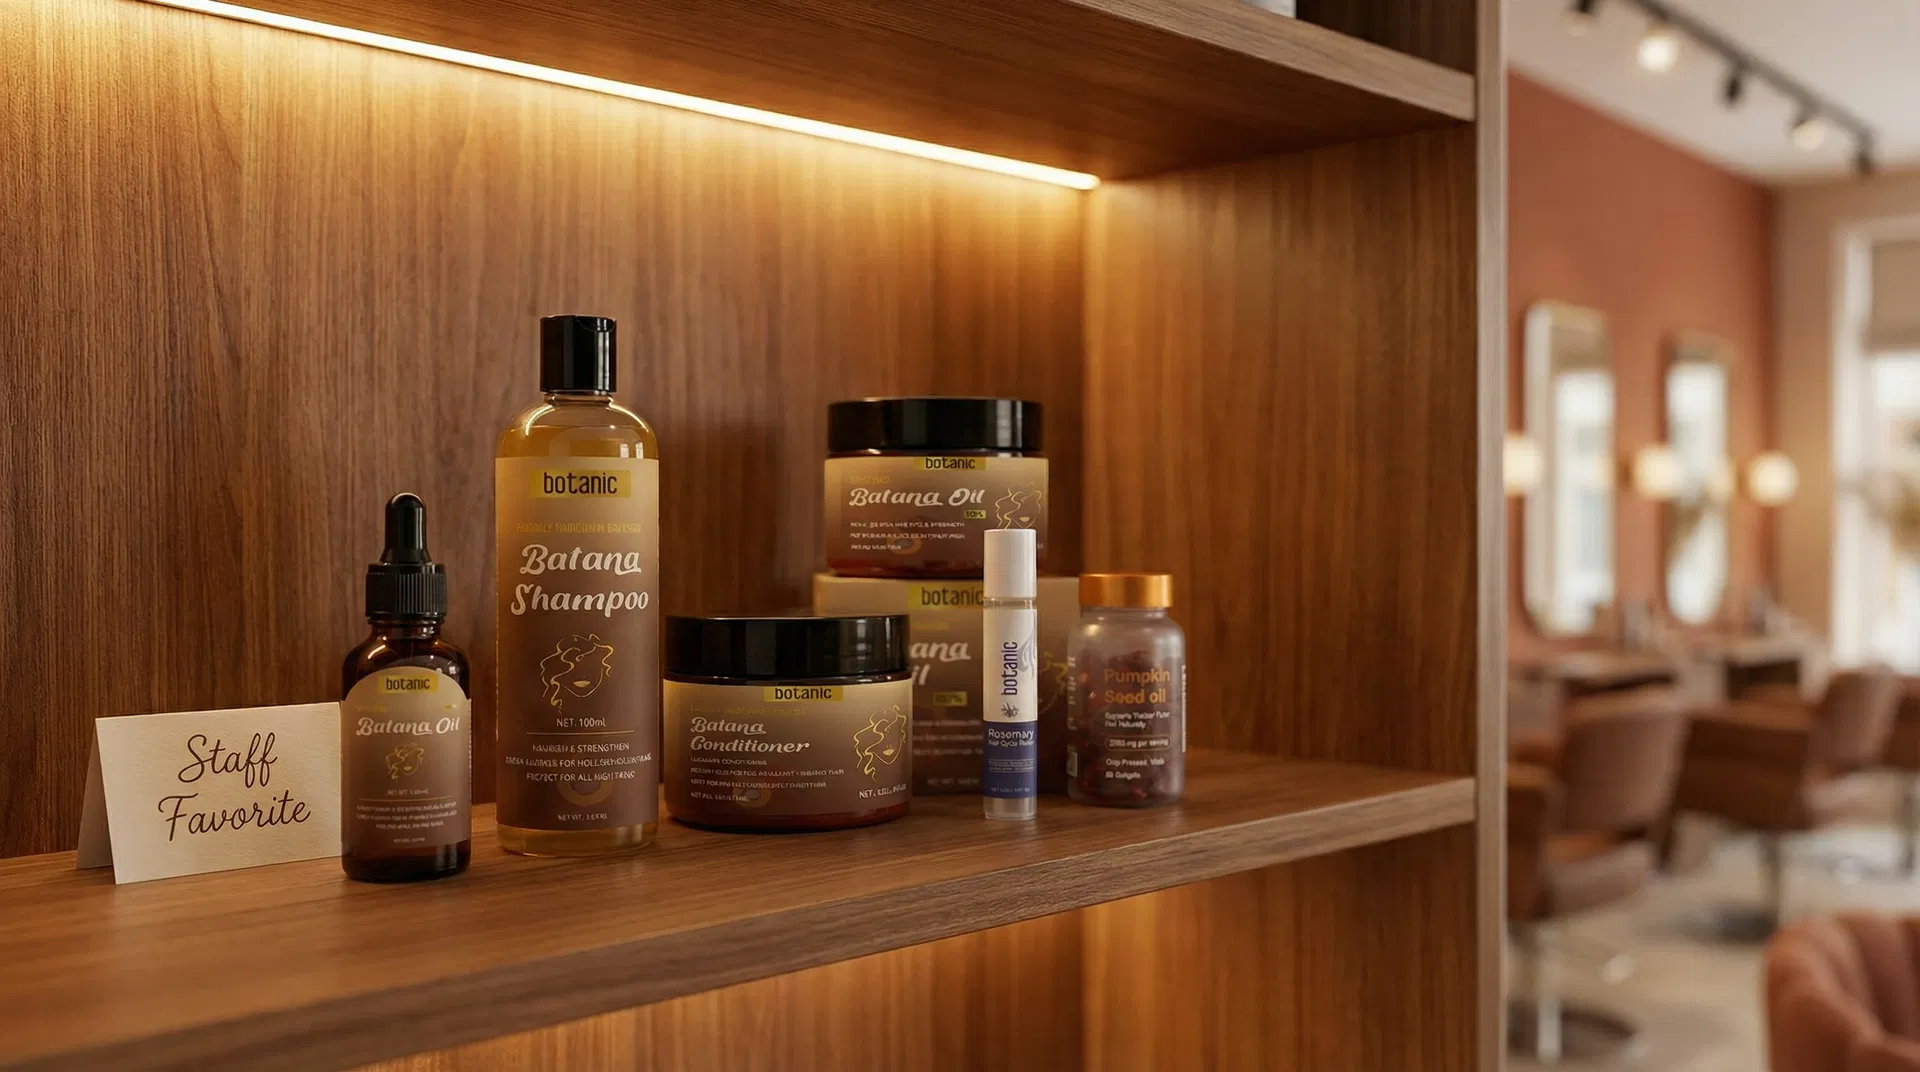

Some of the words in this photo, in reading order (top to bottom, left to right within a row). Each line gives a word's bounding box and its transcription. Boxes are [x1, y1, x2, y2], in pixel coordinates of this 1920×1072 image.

[925, 457, 976, 469] botanic
[543, 472, 618, 494] botanic
[848, 487, 944, 507] Batana
[948, 487, 986, 507] Oil
[519, 544, 642, 576] Batana
[510, 583, 650, 618] Shampoo
[911, 642, 971, 662] ana
[1001, 641, 1018, 696] botanic
[1104, 668, 1170, 686] Pumpkin
[386, 677, 430, 691] botanic
[774, 686, 832, 700] botanic
[355, 717, 433, 736] Batana
[436, 717, 460, 734] Oil
[578, 717, 607, 727] 100ml
[690, 716, 767, 735] Batana
[690, 735, 810, 754] Conditioner
[178, 732, 278, 789] Staff
[158, 790, 311, 842] Favorite
